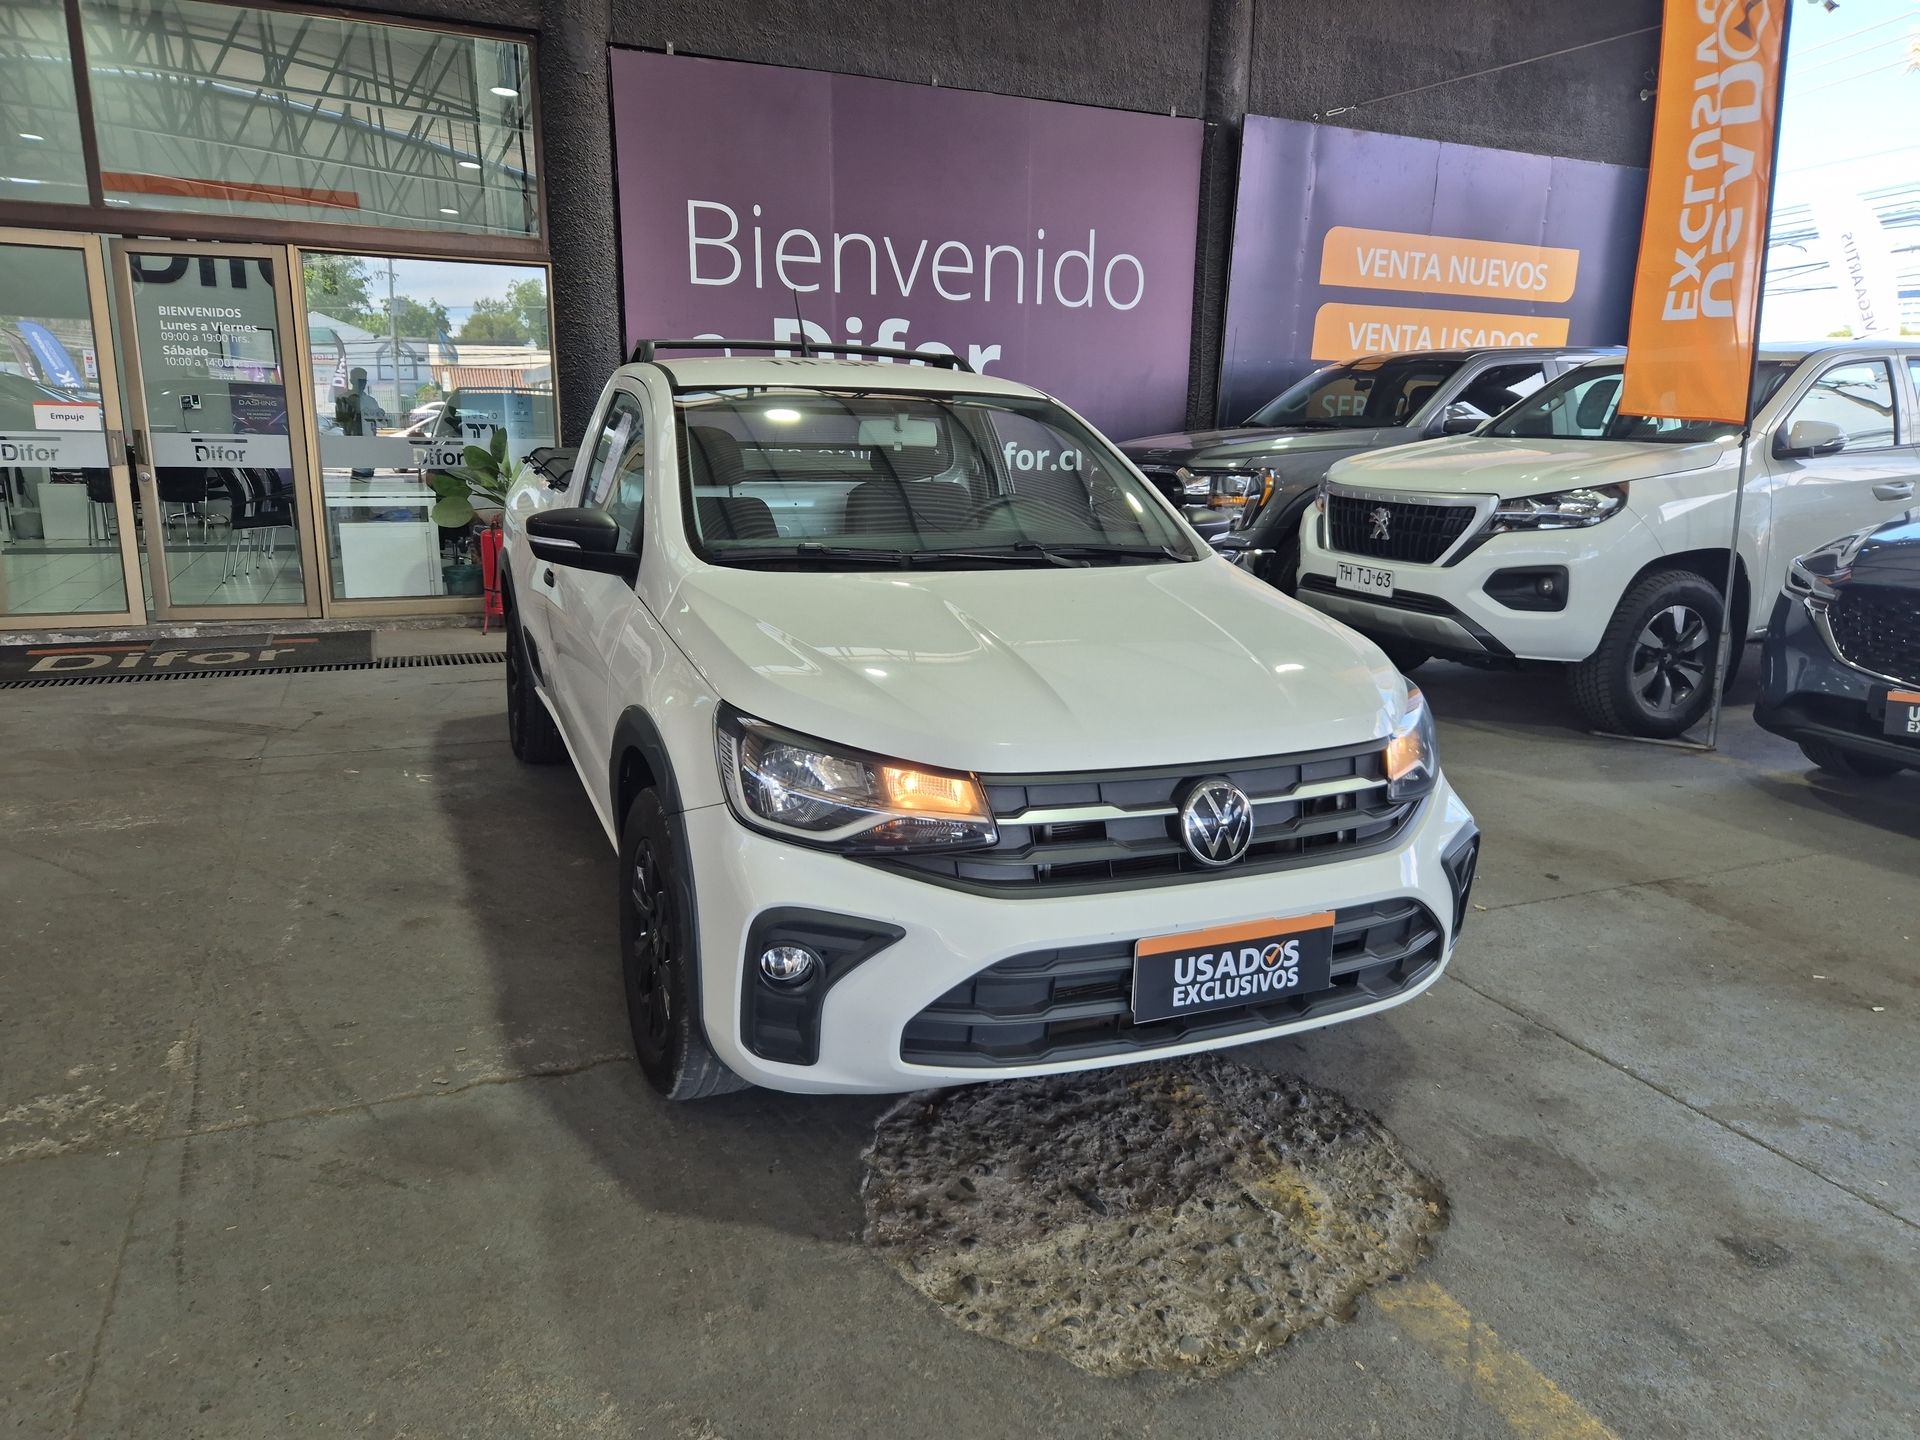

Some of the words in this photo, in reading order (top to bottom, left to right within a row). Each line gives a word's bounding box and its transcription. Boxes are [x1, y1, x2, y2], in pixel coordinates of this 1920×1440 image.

[687, 199, 1145, 310] Bienvenido
[1356, 246, 1441, 282] VENTA
[1448, 255, 1549, 291] NUEVOS
[158, 305, 242, 318] BIENVENIDOS
[160, 320, 197, 331] Lunes
[200, 323, 208, 331] a
[211, 321, 258, 333] Viernes
[160, 332, 190, 342] 09:00
[202, 333, 229, 343] 19:00
[231, 334, 250, 344] hrs.
[1348, 321, 1434, 352] VENTA
[162, 344, 209, 356] Sábado
[165, 356, 192, 366] 10:00
[205, 357, 230, 367] 14:00
[50, 412, 85, 421] Empuje
[1, 443, 60, 461] Difor
[194, 445, 246, 462] Difor
[28, 649, 296, 673] Difor
[1174, 939, 1300, 985] USADOS
[1172, 966, 1299, 1007] EXCLUSIVOS
